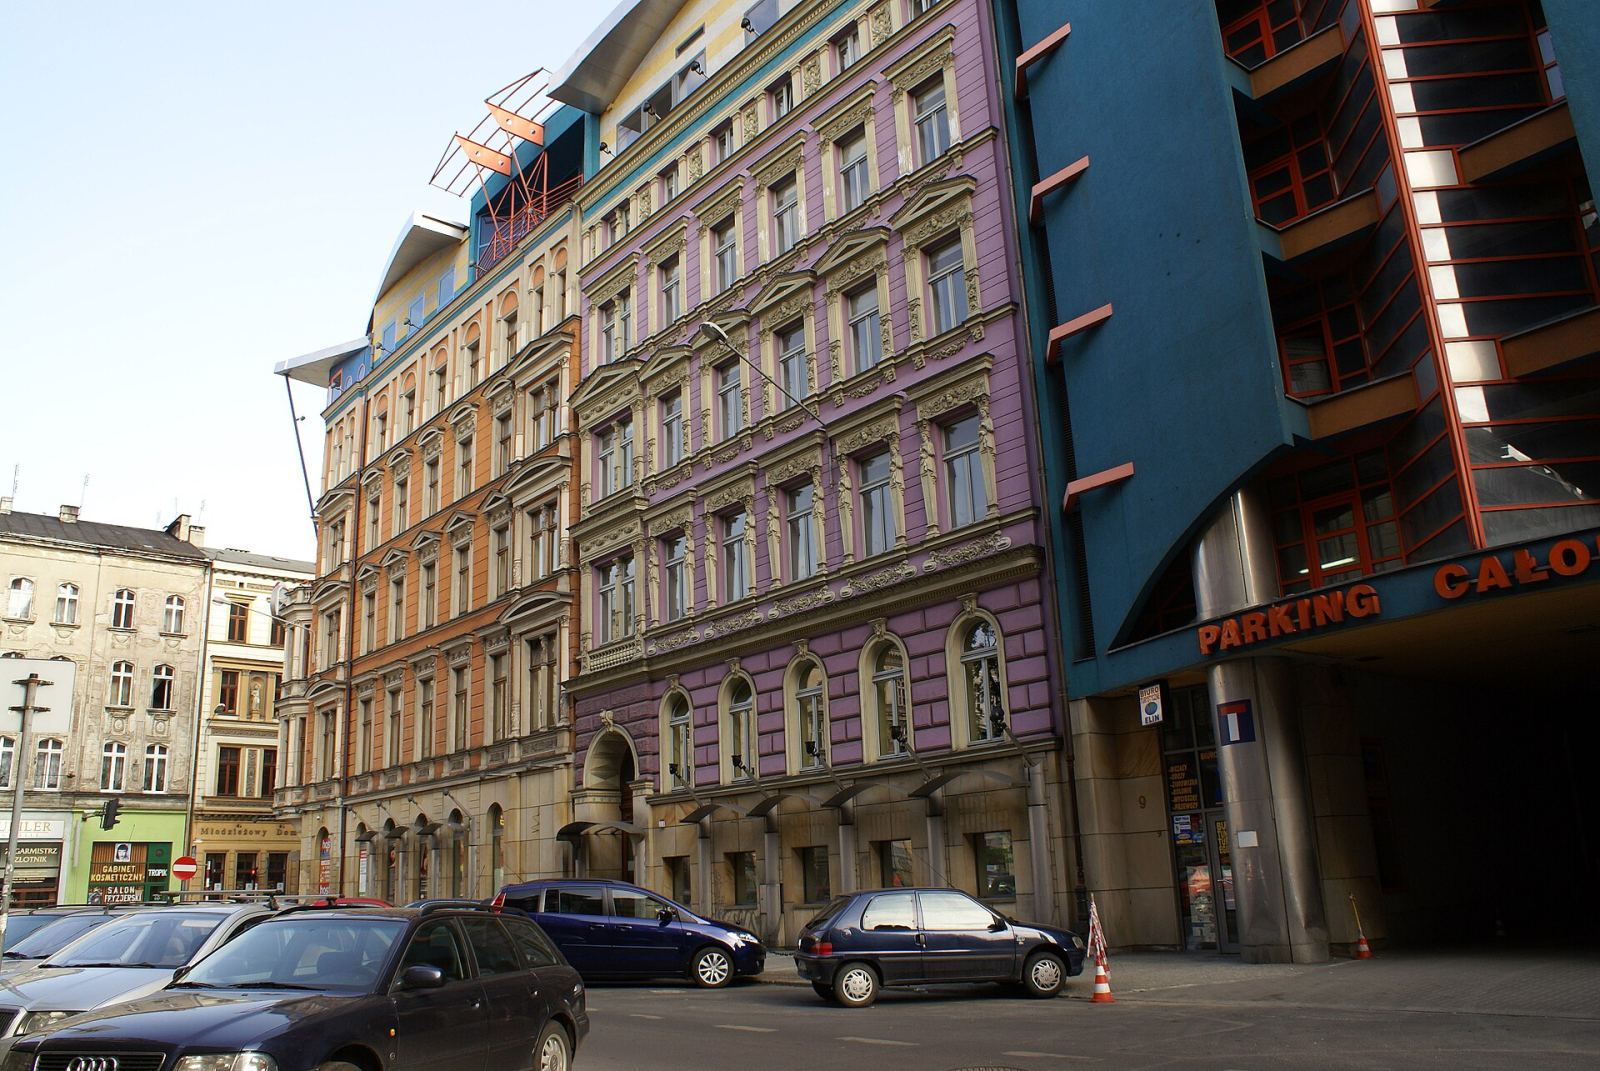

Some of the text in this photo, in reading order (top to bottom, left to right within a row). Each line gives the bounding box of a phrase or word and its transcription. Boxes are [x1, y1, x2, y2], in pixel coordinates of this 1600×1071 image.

[1198, 533, 1600, 656] PARKING CAŁO
[1144, 714, 1160, 724] ELIN
[102, 865, 136, 873] GABINET
[148, 868, 168, 877] TROPIK
[107, 886, 136, 894] SALON
